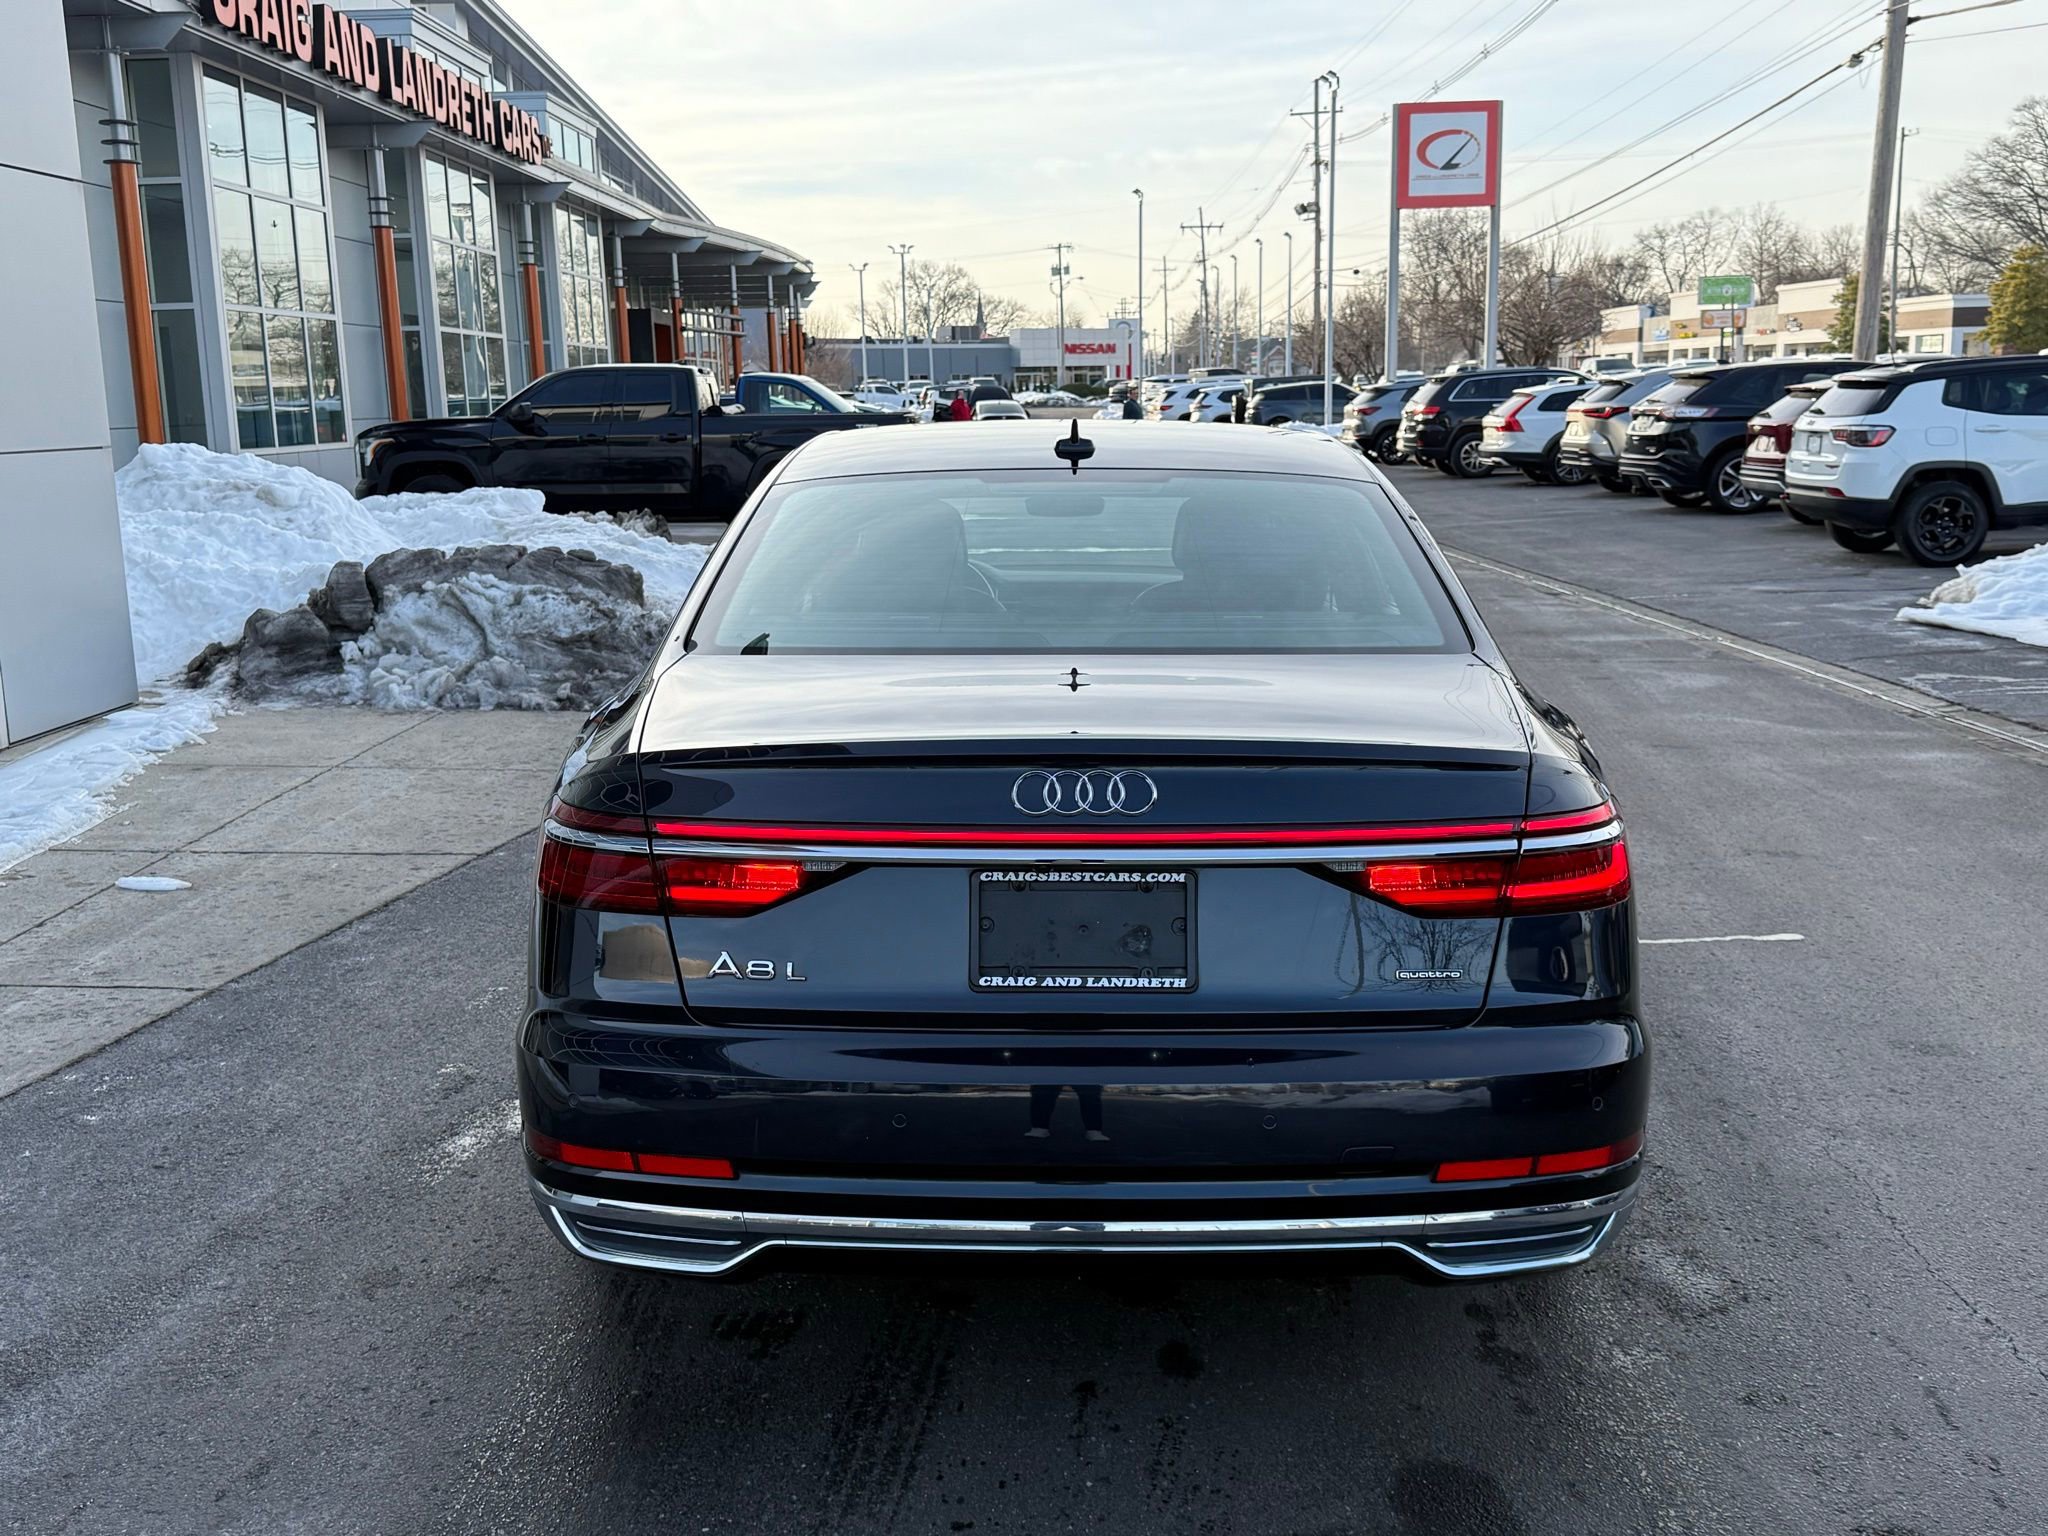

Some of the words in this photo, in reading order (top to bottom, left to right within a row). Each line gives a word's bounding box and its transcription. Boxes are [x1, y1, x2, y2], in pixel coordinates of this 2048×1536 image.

[323, 4, 380, 93] AND
[386, 38, 497, 146] LANDRETH
[499, 98, 543, 167] CARS
[1064, 343, 1117, 354] NISSAN
[979, 871, 1187, 883] CRAIGSBESTCARS.COM
[706, 951, 775, 980] A8
[786, 961, 807, 981] L
[1398, 970, 1461, 980] quattro
[978, 976, 1037, 987] CRAIG
[1041, 976, 1082, 987] AND
[1085, 977, 1187, 988] LANDRETH
